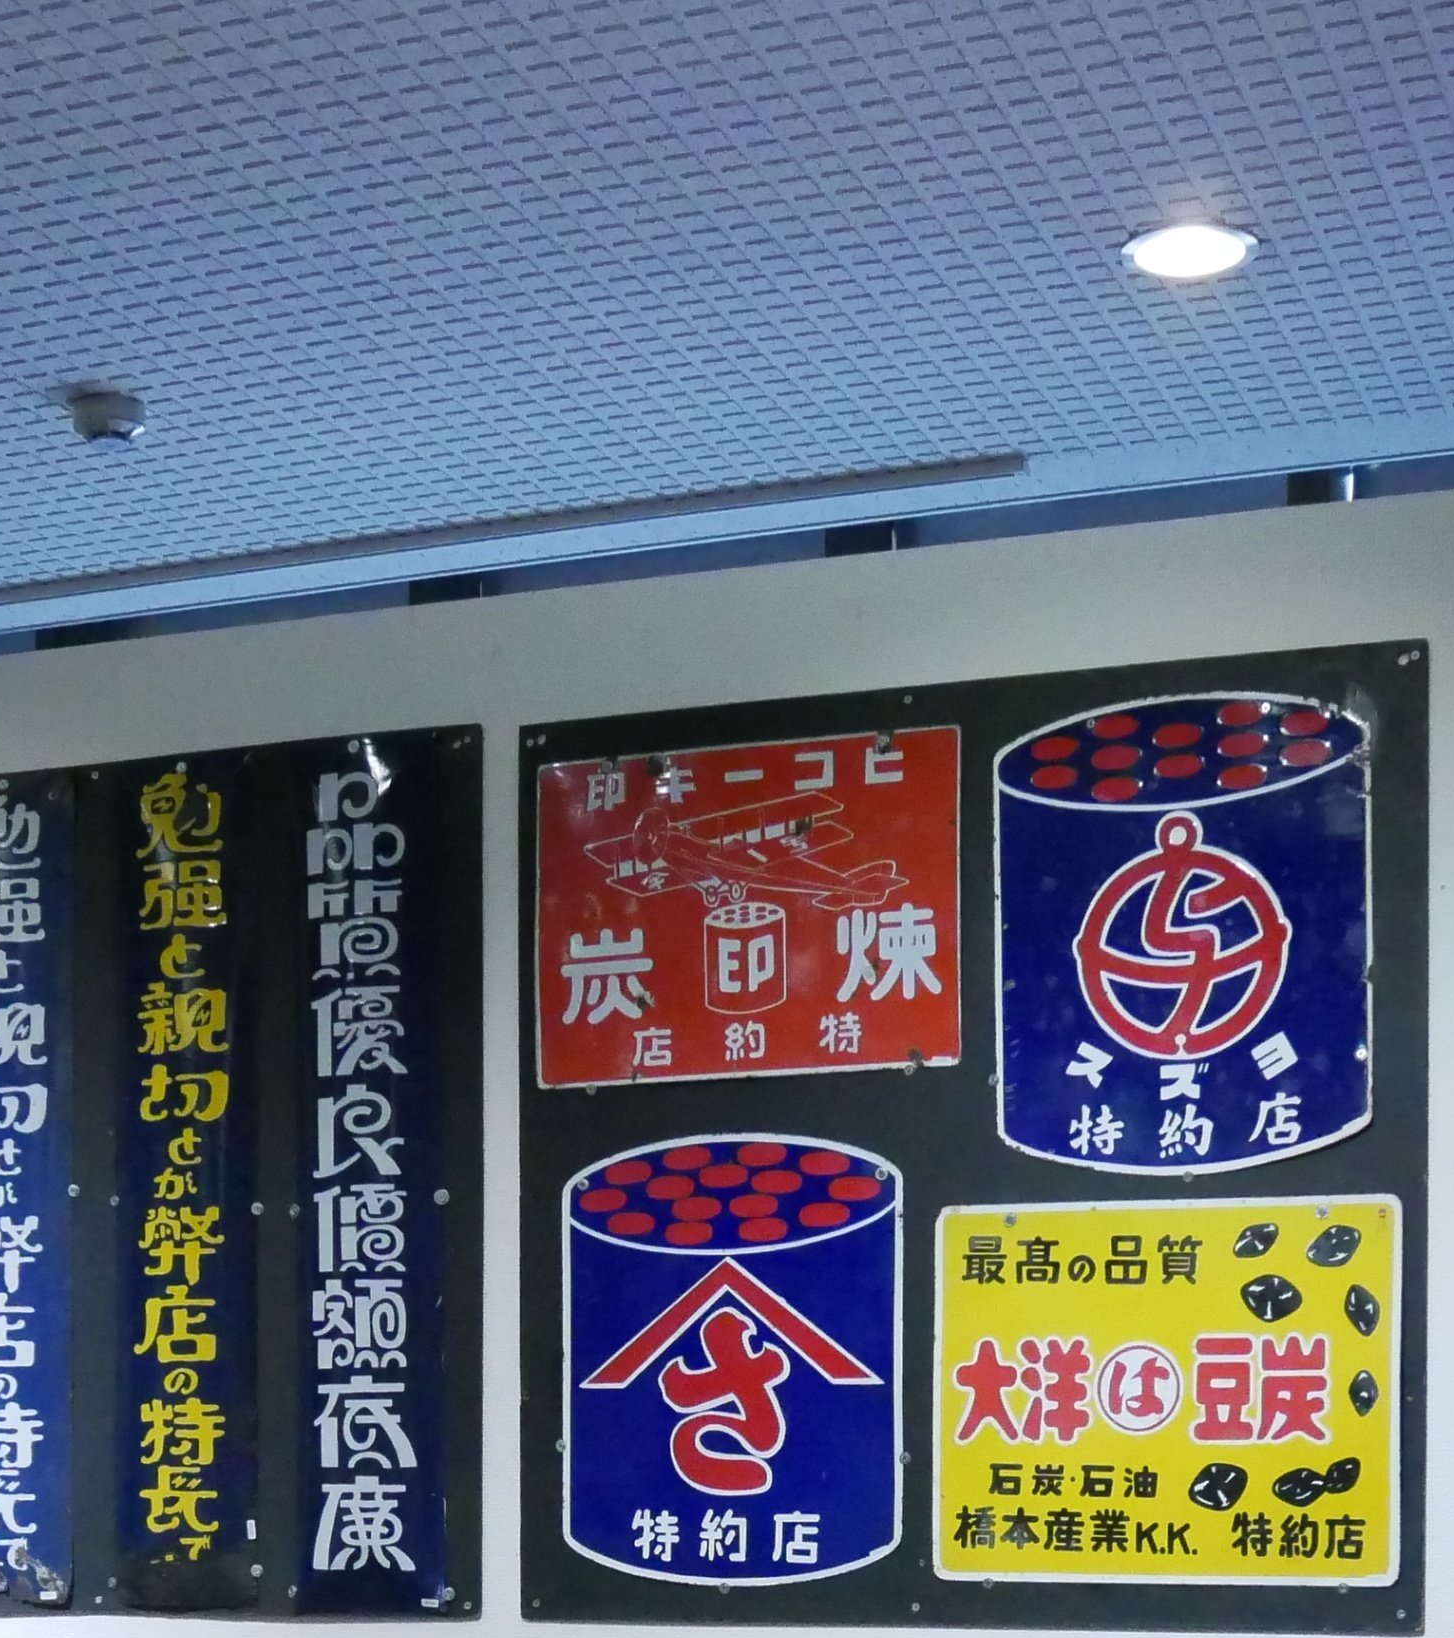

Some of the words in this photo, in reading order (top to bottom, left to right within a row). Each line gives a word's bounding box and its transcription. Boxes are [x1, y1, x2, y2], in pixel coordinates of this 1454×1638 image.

[632, 1011, 863, 1068] 特約店
[1065, 1031, 1299, 1103] スズヨ
[1068, 1092, 1303, 1159] 特約店
[952, 1332, 1332, 1446] 大洋は豆炭
[631, 1507, 822, 1565] 特約店
[1231, 1511, 1367, 1561] 特約店
